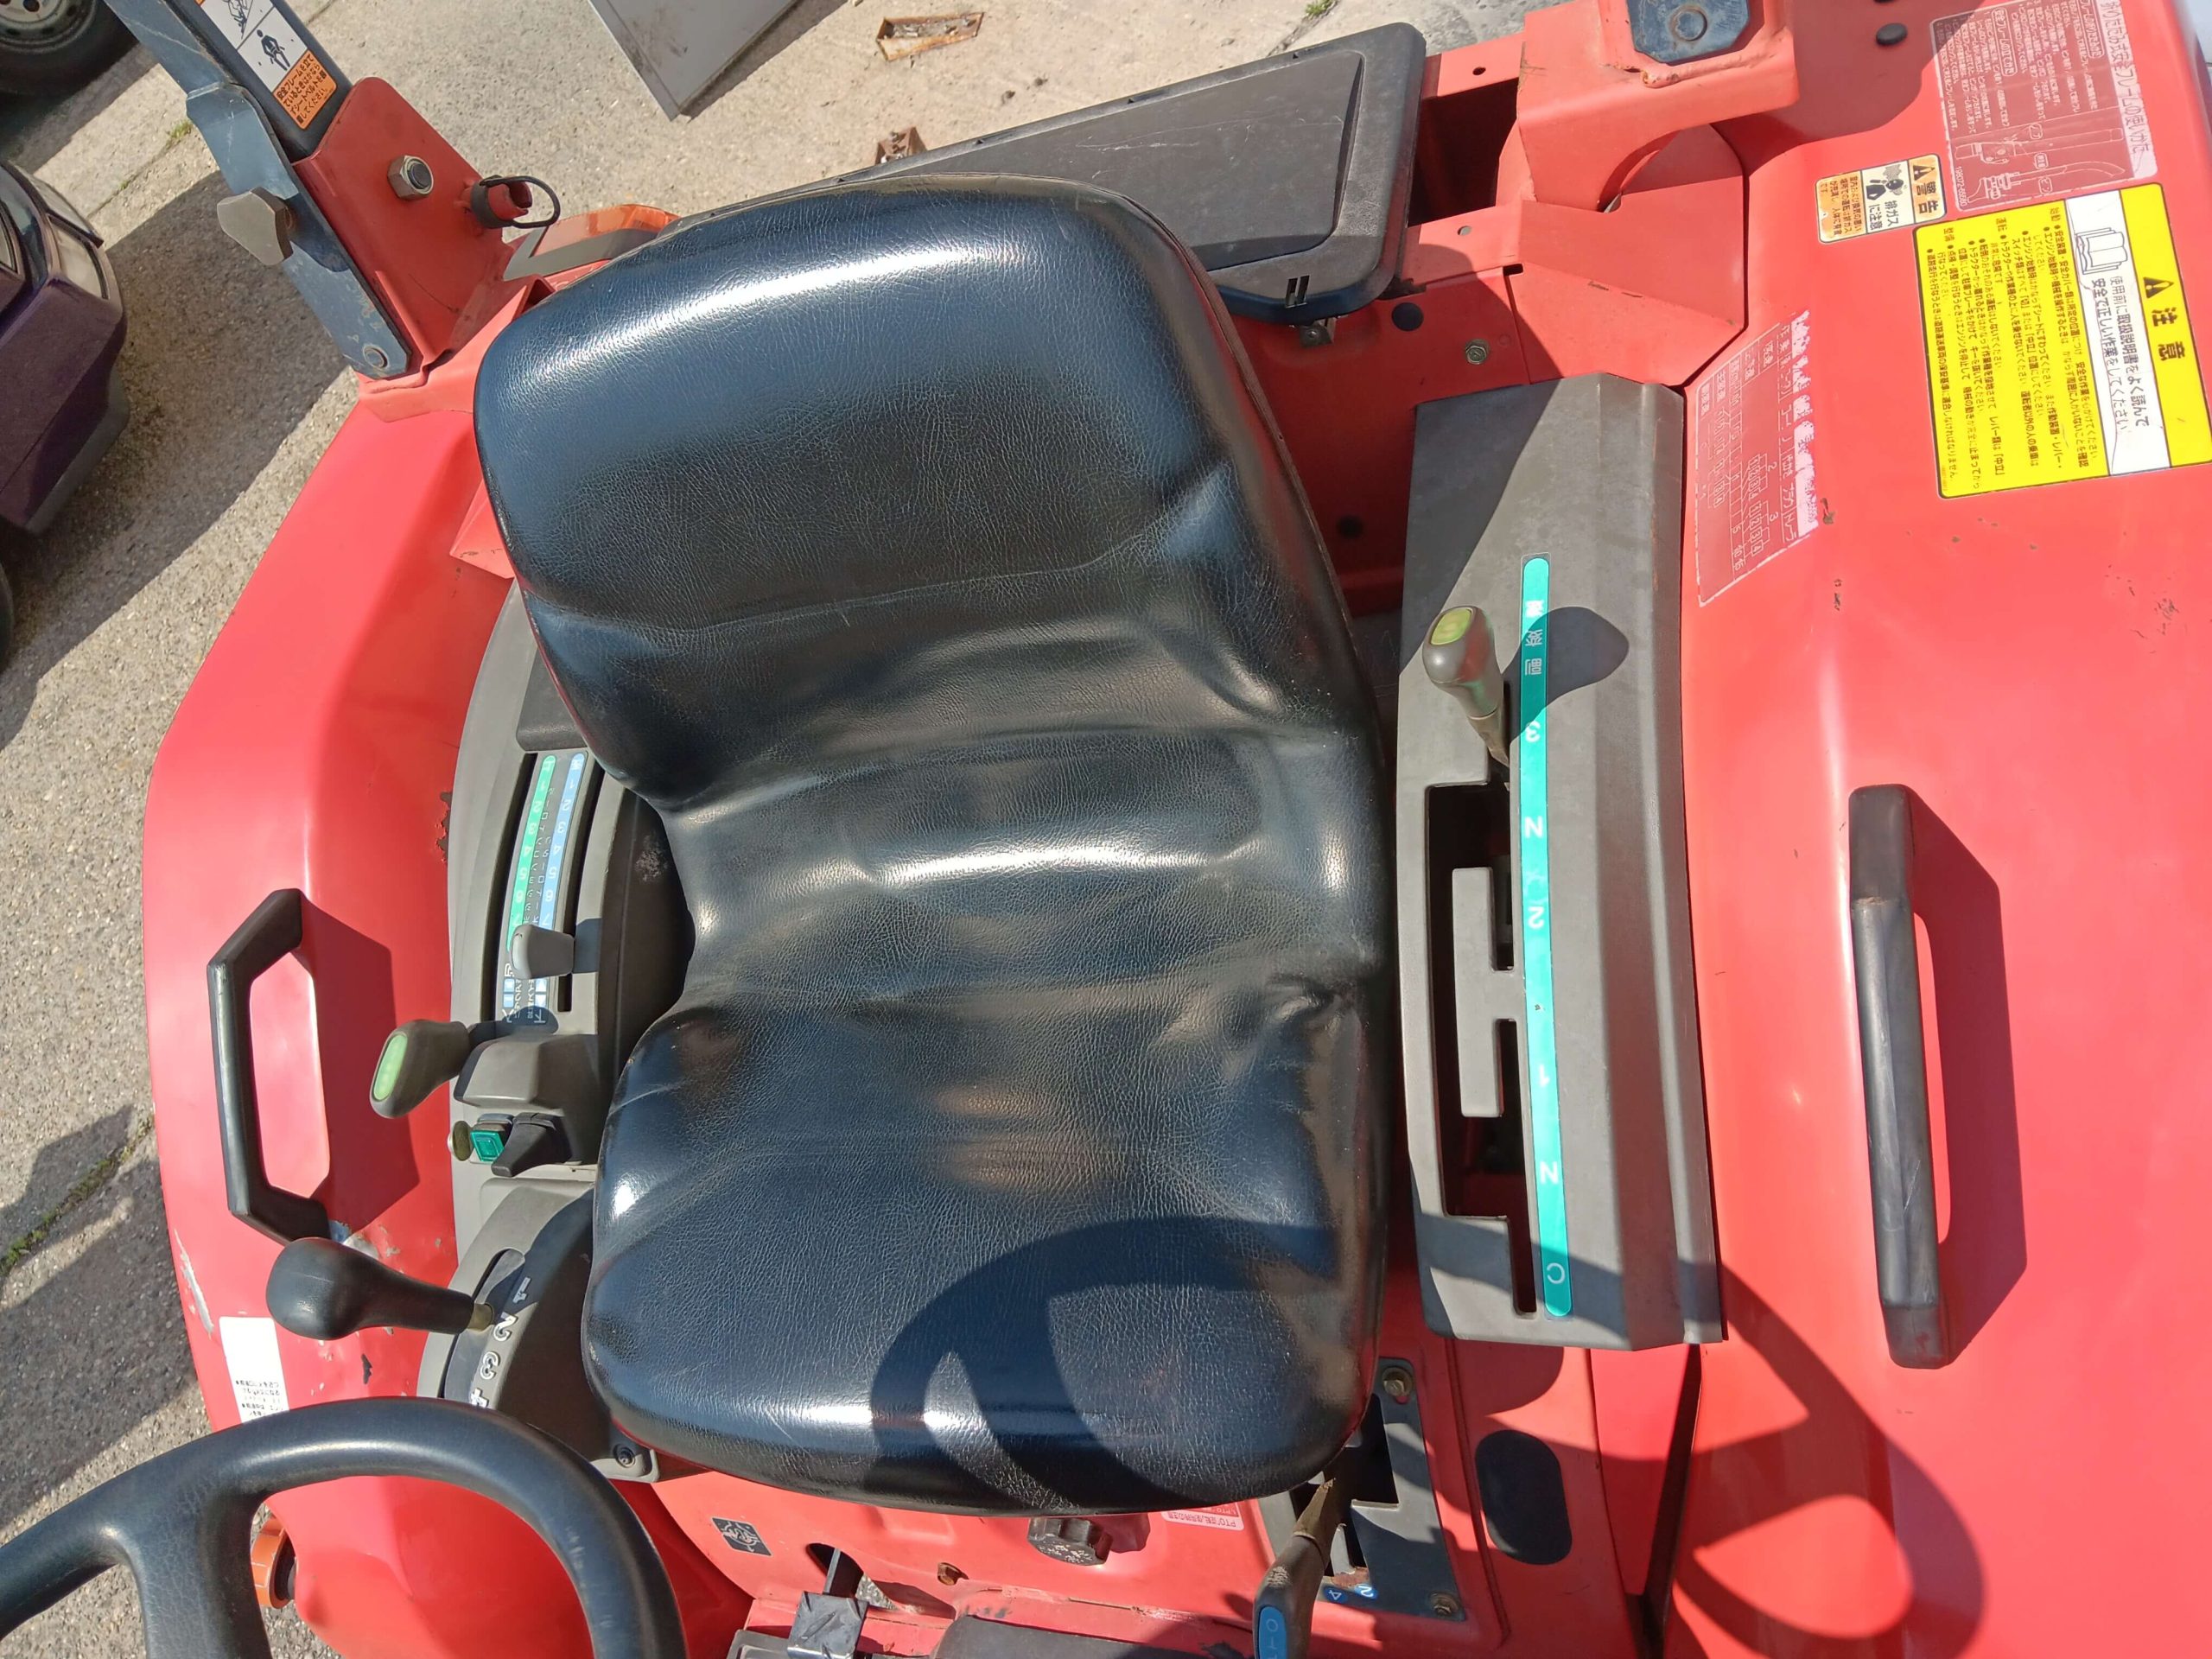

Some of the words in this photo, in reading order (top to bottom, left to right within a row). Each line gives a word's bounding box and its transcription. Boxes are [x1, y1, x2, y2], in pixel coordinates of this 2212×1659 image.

[275, 54, 315, 100] 安全フレームを立て
[282, 61, 321, 108] ているときはかなら
[289, 69, 327, 116] ずシートベルトを
[296, 84, 327, 124] してください。
[1916, 181, 1939, 214] 警告
[1868, 203, 1882, 230] に注意
[1884, 200, 1898, 226] 排ガス
[2090, 277, 2131, 430] 安全で正しい作業をしてください
[2107, 275, 2151, 428] 使用前に取扱説明書をよく読んで
[1767, 461, 1777, 473] 2
[1769, 510, 1778, 523] 3
[1525, 721, 1541, 742] 3
[533, 800, 542, 812] 2
[562, 799, 571, 810] 2
[557, 822, 566, 833] 3
[1524, 816, 1543, 838] N
[554, 845, 562, 855] 4
[549, 867, 557, 879] 5
[545, 891, 554, 901] 6
[1528, 906, 1545, 929] 2
[533, 1009, 546, 1023] 下
[1539, 1065, 1549, 1087] 1
[1539, 1161, 1559, 1185] N
[1546, 1262, 1566, 1284] C
[512, 1277, 531, 1303] 1
[493, 1311, 518, 1342] 2
[480, 1351, 499, 1380] 3
[470, 1388, 488, 1408] 4
[1328, 1589, 1342, 1600] 4
[1357, 1585, 1373, 1598] 2
